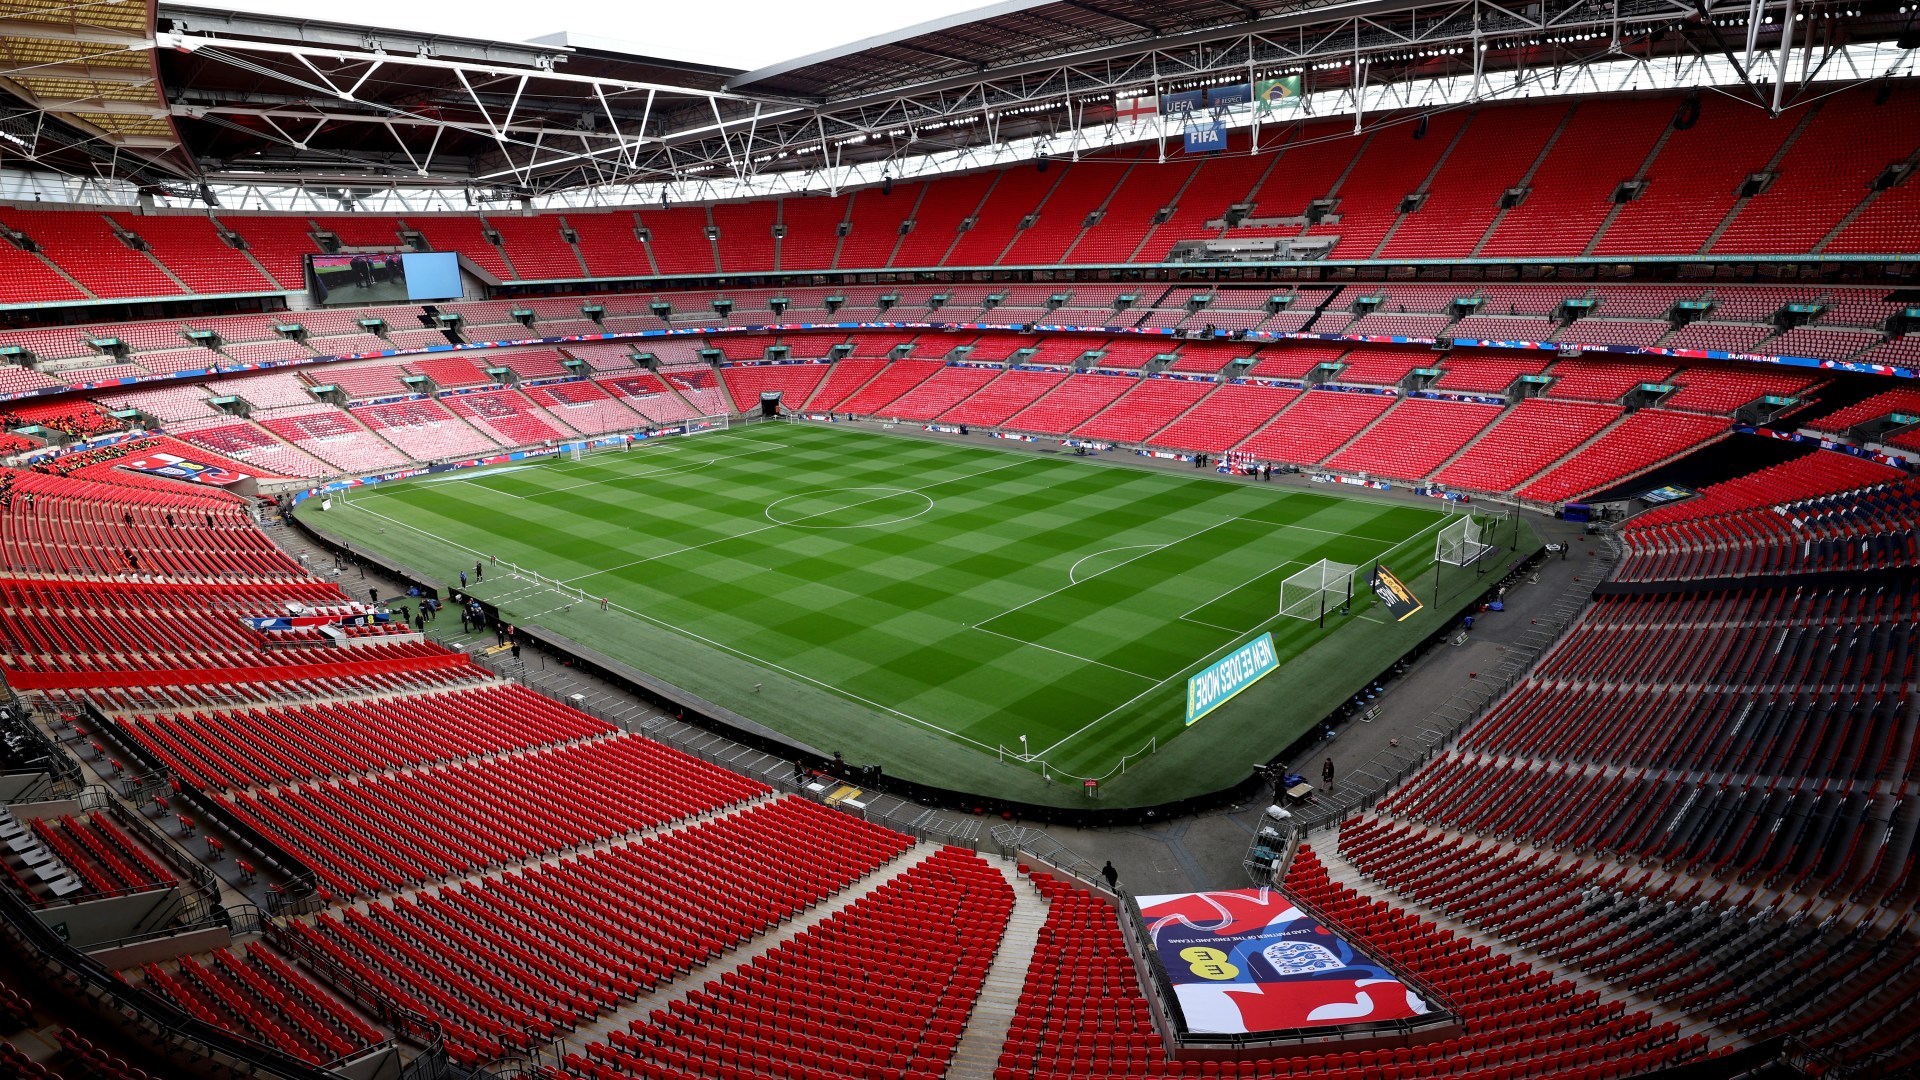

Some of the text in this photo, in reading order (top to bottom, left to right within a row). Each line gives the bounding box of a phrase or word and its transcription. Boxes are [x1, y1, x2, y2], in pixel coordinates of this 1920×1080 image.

[1167, 100, 1194, 112] UEFA
[1221, 96, 1242, 104] RESPECT
[1190, 130, 1219, 144] FIFA
[0, 393, 14, 401] ENJOY
[414, 468, 430, 476] GAME
[1252, 638, 1273, 671] NEW
[1241, 648, 1254, 679] EE
[1220, 654, 1243, 693] DOES
[1196, 667, 1220, 711] MORE
[1257, 931, 1291, 939] PARTNER
